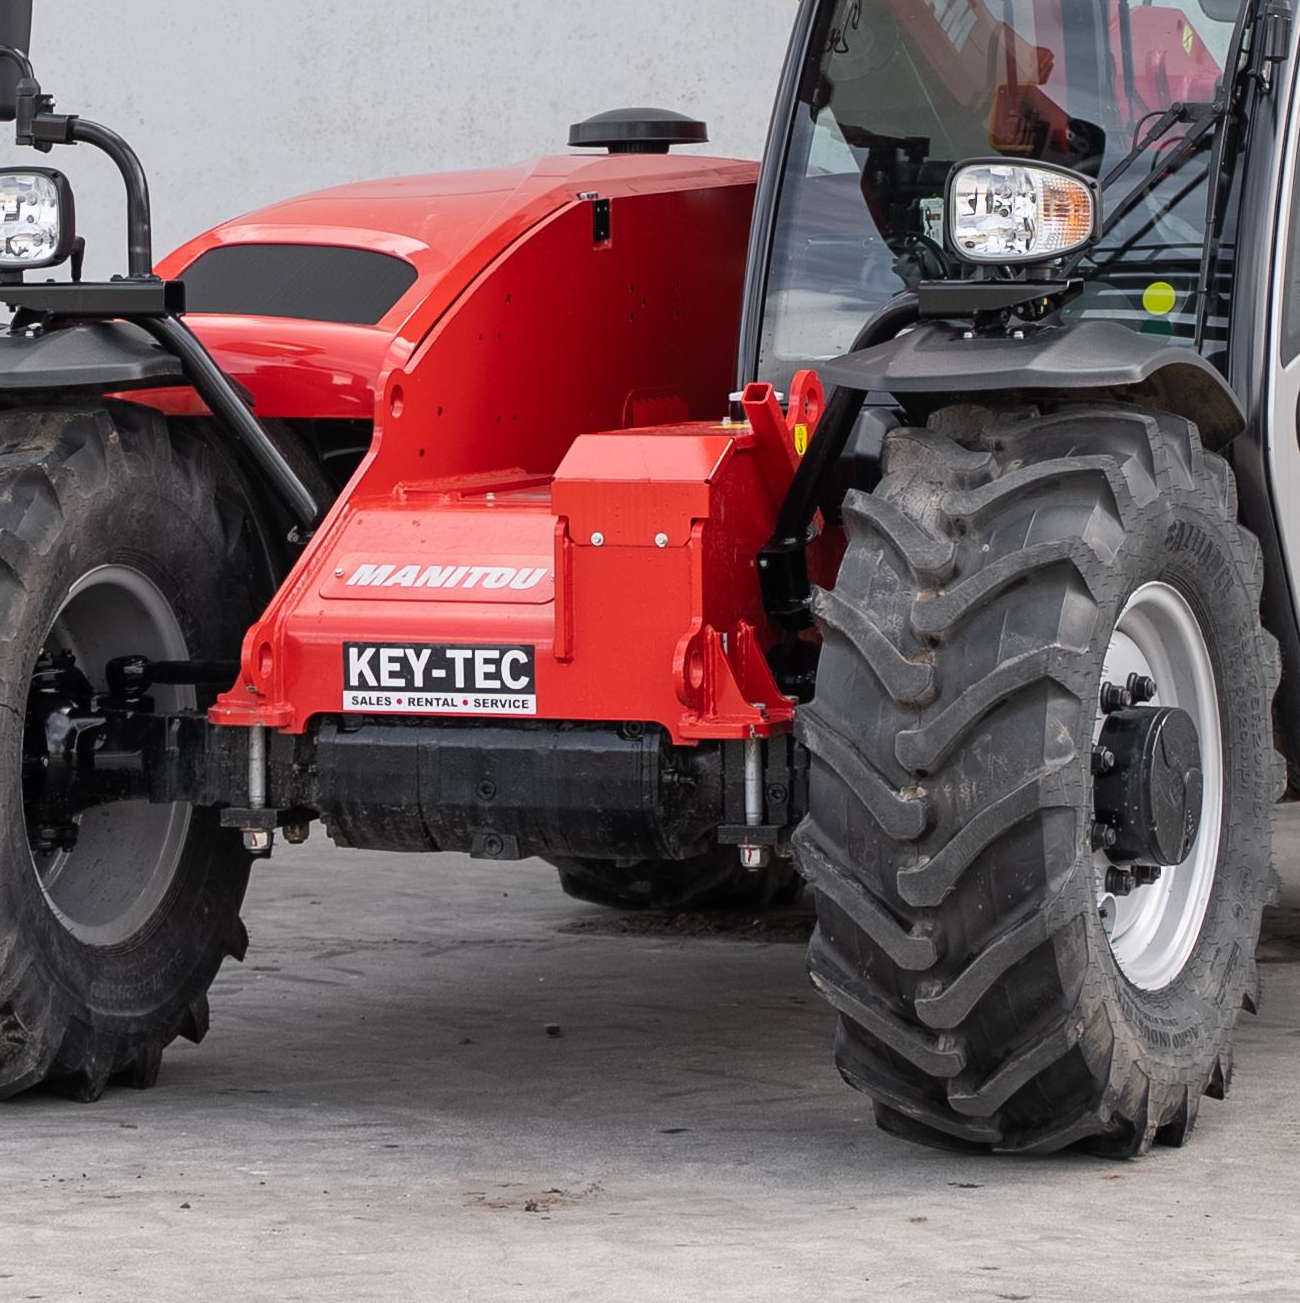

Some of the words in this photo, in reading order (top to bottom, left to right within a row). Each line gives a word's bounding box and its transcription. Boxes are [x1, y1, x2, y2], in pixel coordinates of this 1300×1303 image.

[1170, 519, 1234, 599] ALLIANCE
[345, 564, 548, 589] MANITOU
[349, 647, 530, 689] KEY-TEC
[351, 696, 392, 706] SALES
[408, 697, 458, 708] RENTAL
[473, 698, 530, 709] SERVICE
